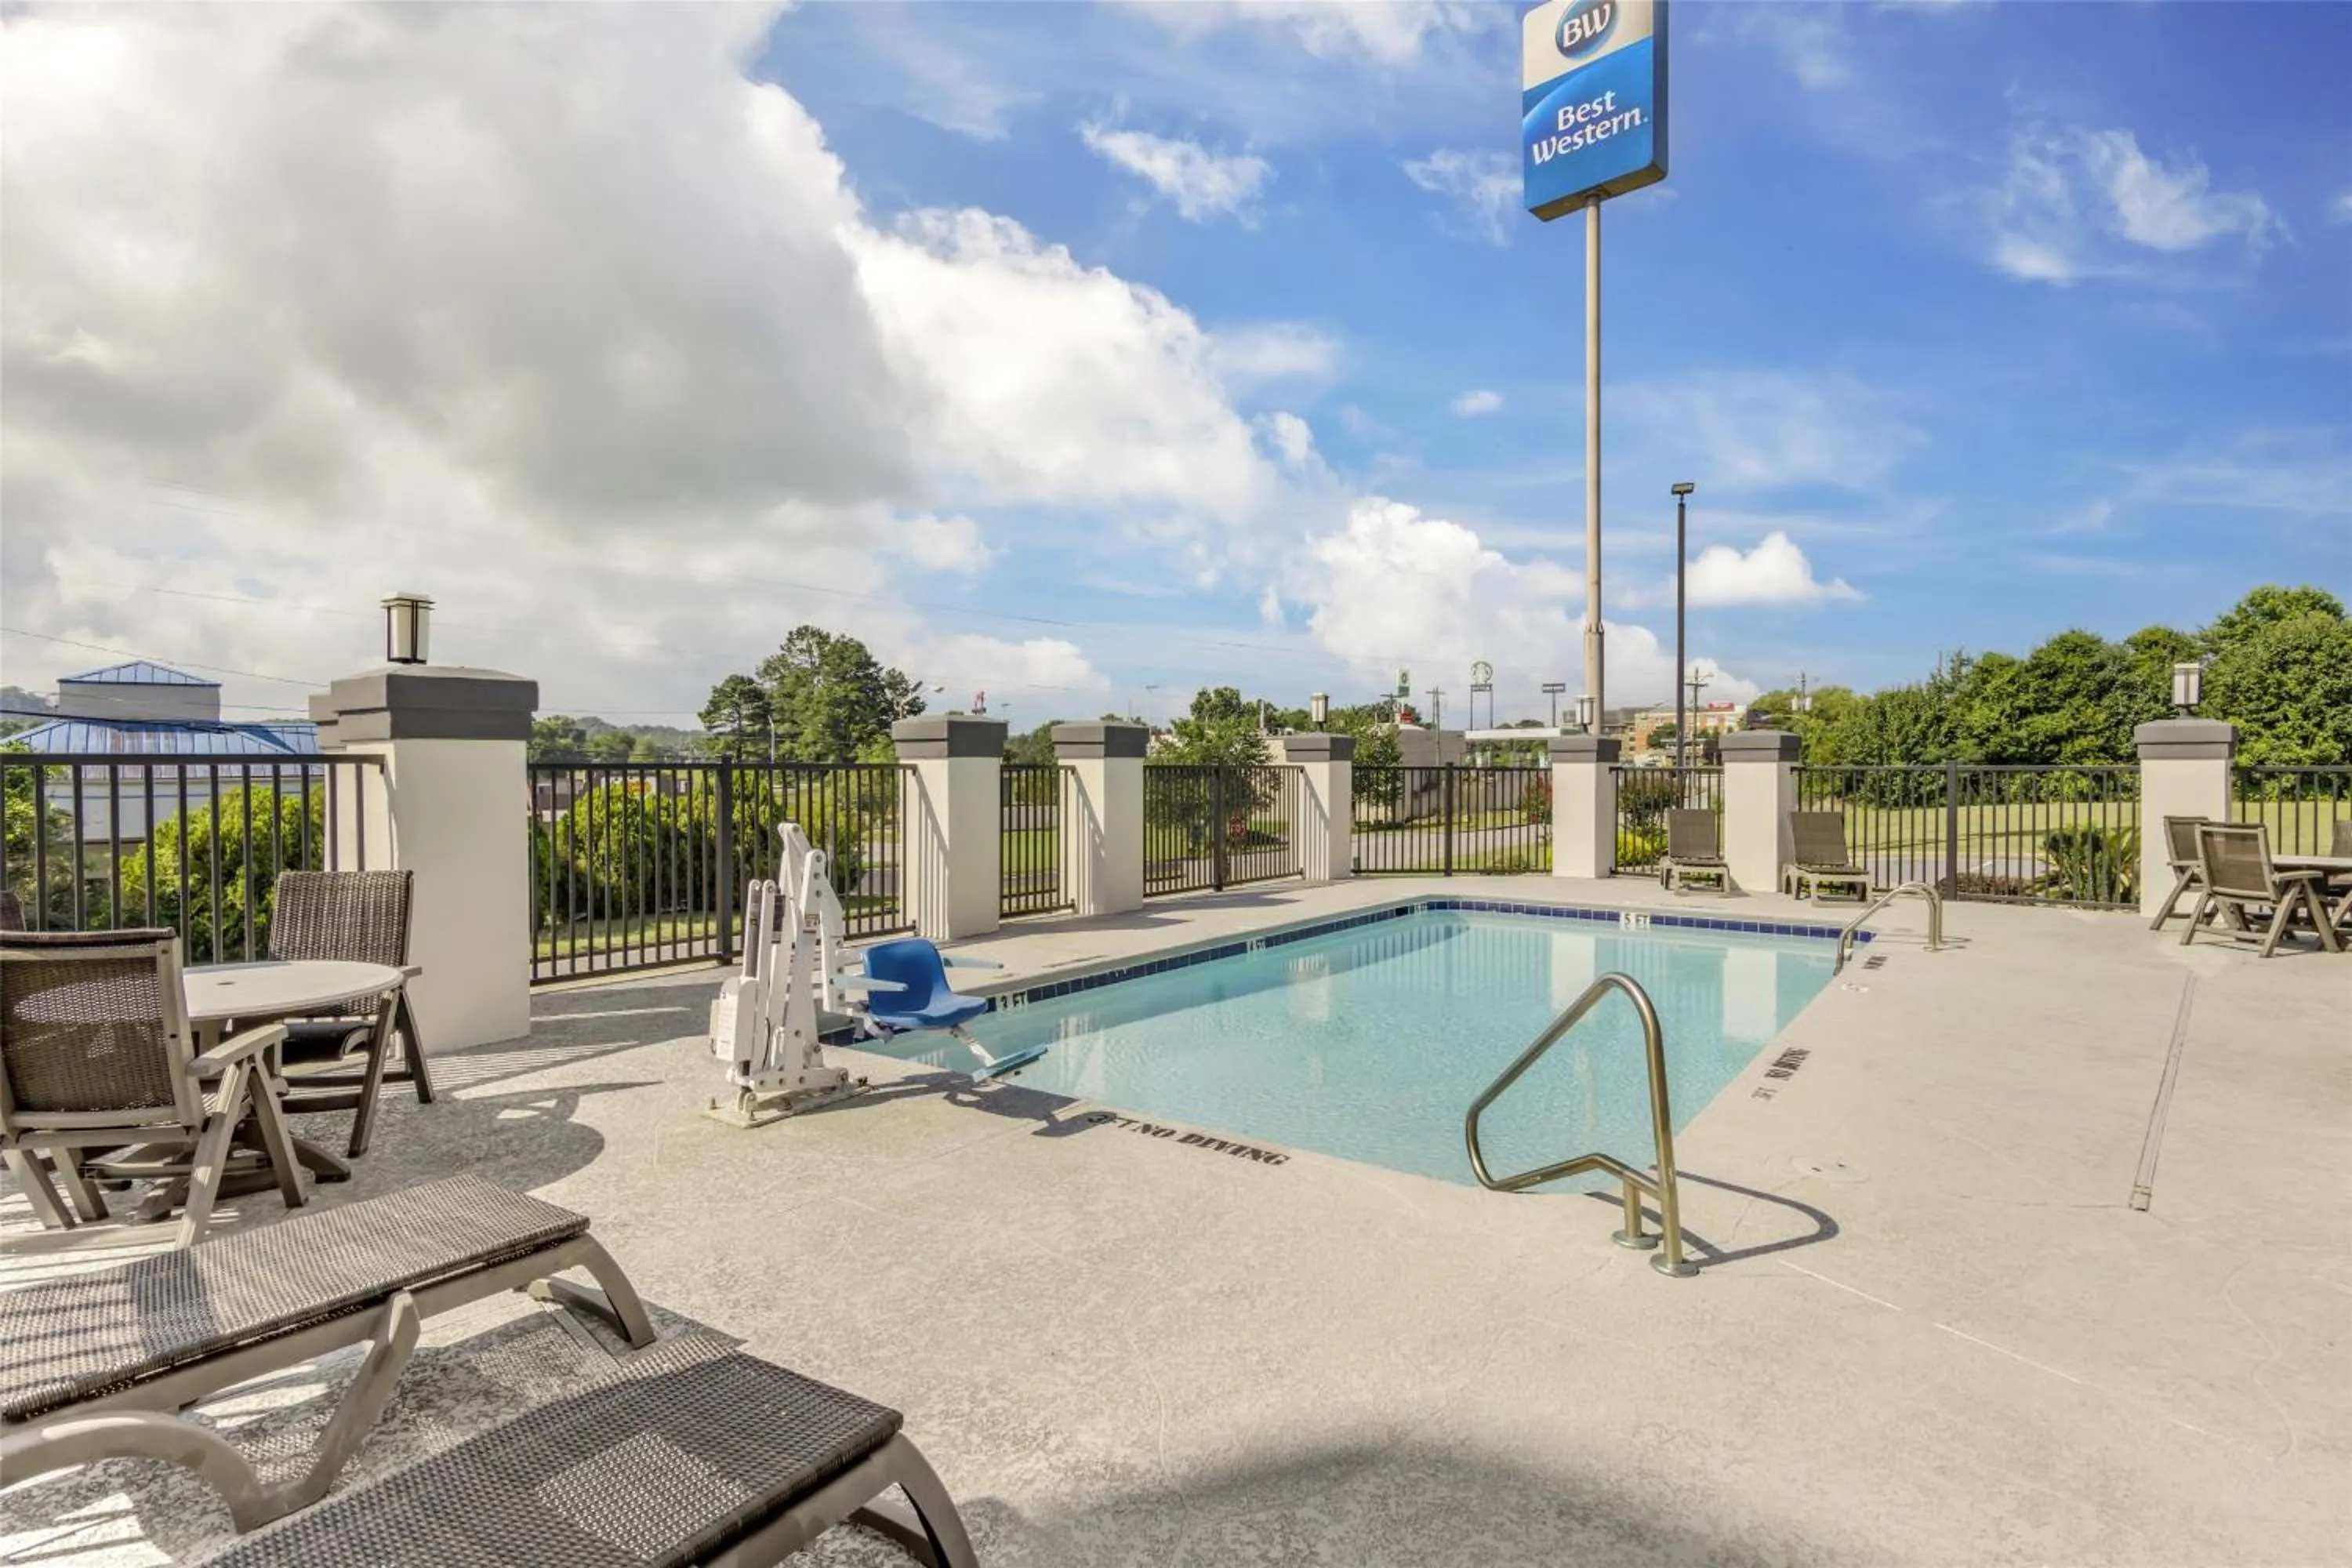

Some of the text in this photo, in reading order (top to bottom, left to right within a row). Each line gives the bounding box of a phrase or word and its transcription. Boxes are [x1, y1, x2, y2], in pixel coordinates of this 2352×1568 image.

[1562, 3, 1611, 48] BW
[1557, 89, 1617, 132] Best
[1000, 991, 1026, 1009] 3 FT
[1176, 1133, 1291, 1165] DIVING
